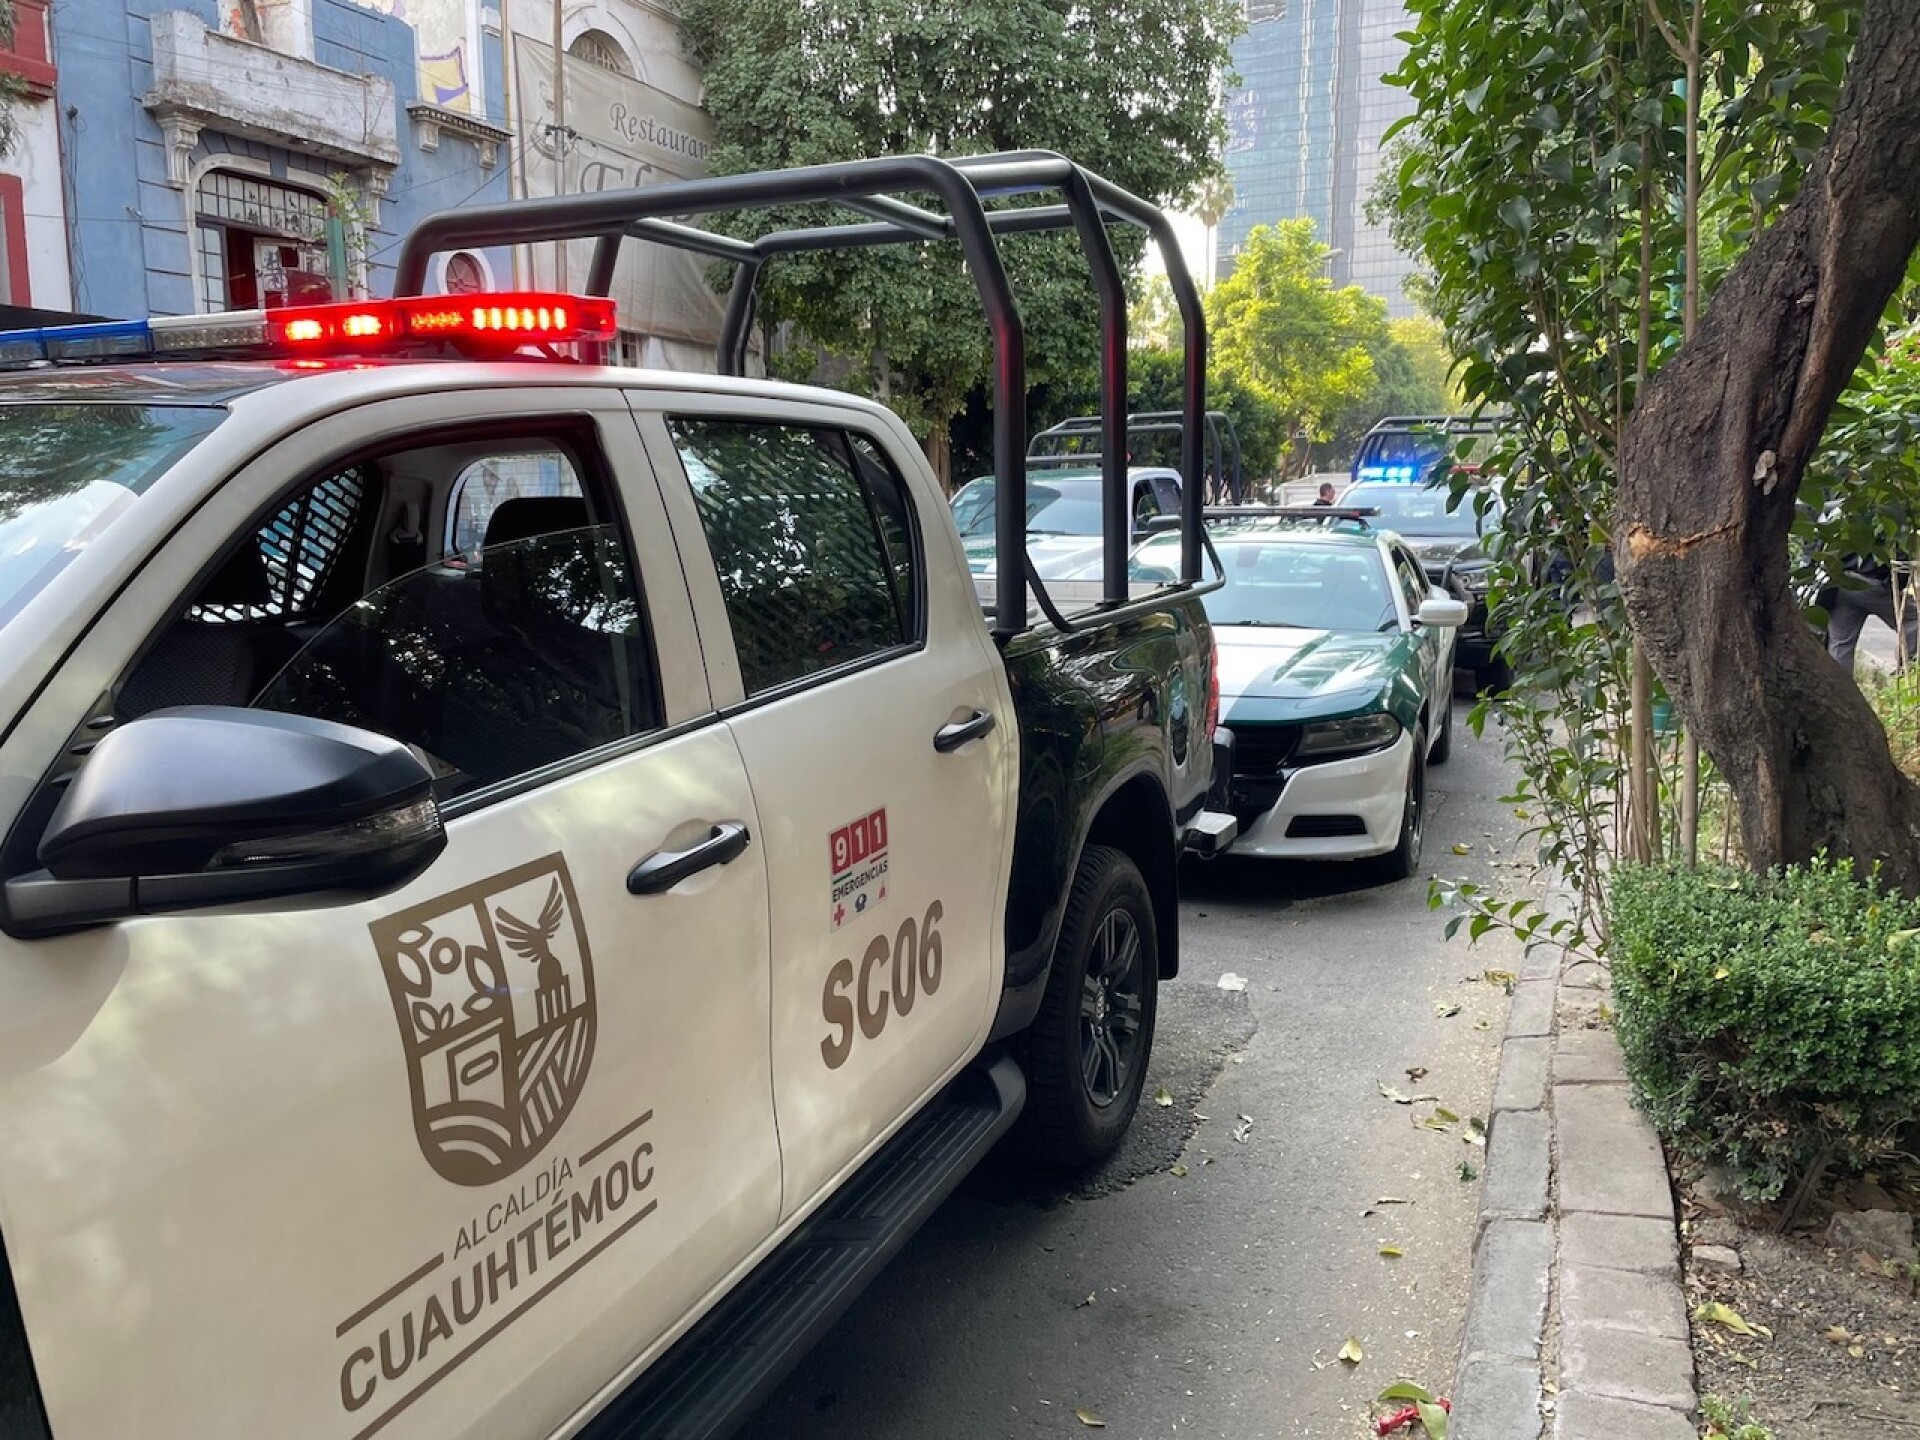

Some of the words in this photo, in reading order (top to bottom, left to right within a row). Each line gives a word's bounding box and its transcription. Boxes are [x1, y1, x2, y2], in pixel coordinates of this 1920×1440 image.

[832, 859, 888, 903] EMERGENCIAS
[835, 815, 883, 868] 911
[820, 899, 944, 1070] SC06
[453, 1156, 574, 1261] ALCALDÍA
[340, 1142, 655, 1412] CUAUHTÉMOC
